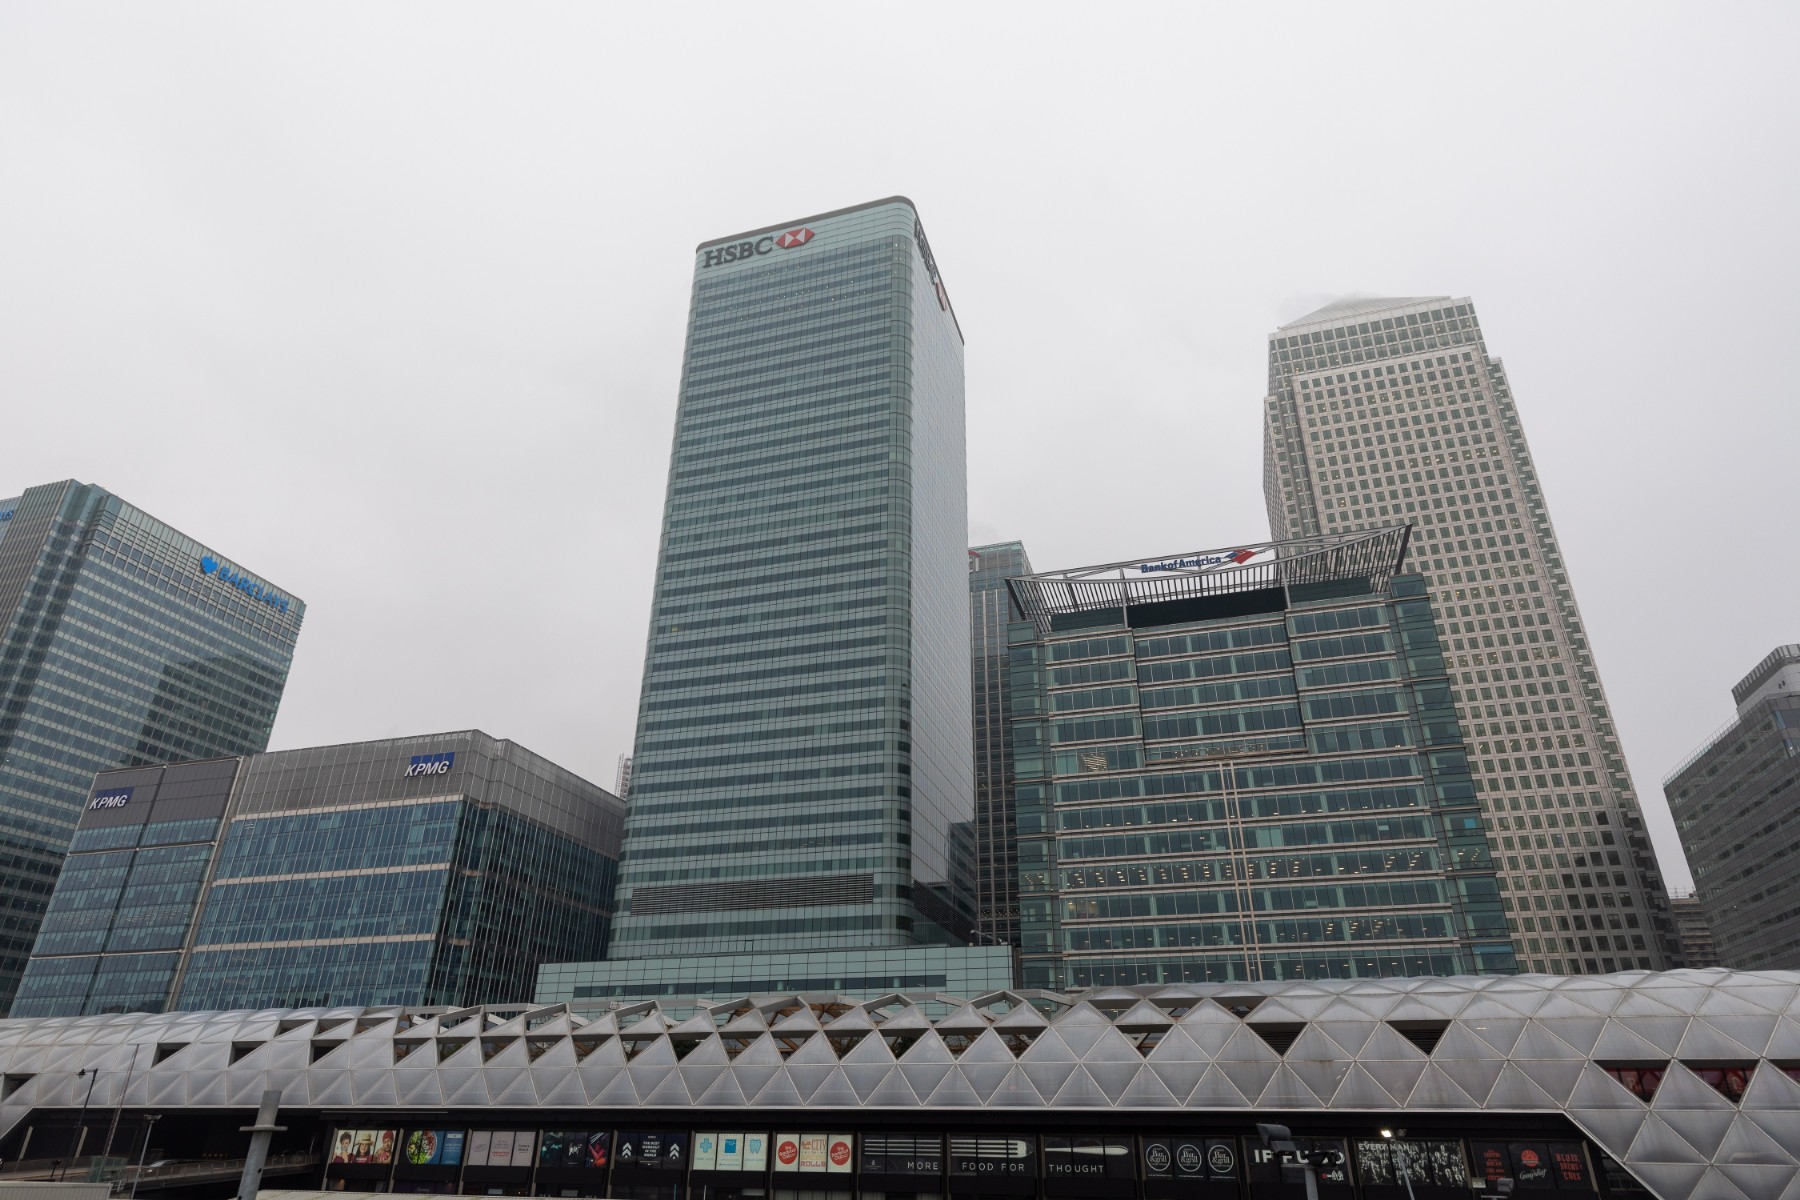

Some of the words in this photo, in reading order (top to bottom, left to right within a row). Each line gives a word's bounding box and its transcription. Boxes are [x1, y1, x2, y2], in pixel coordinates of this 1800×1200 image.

[703, 235, 774, 268] HSBC
[217, 566, 289, 614] BARCLAYS
[404, 760, 450, 777] KPMG
[89, 794, 128, 810] KPMG
[812, 1139, 826, 1150] CITY
[907, 1161, 938, 1170] MORE
[962, 1162, 994, 1171] FOOD
[1001, 1163, 1025, 1171] FOR
[1049, 1164, 1104, 1173] THOUGHT
